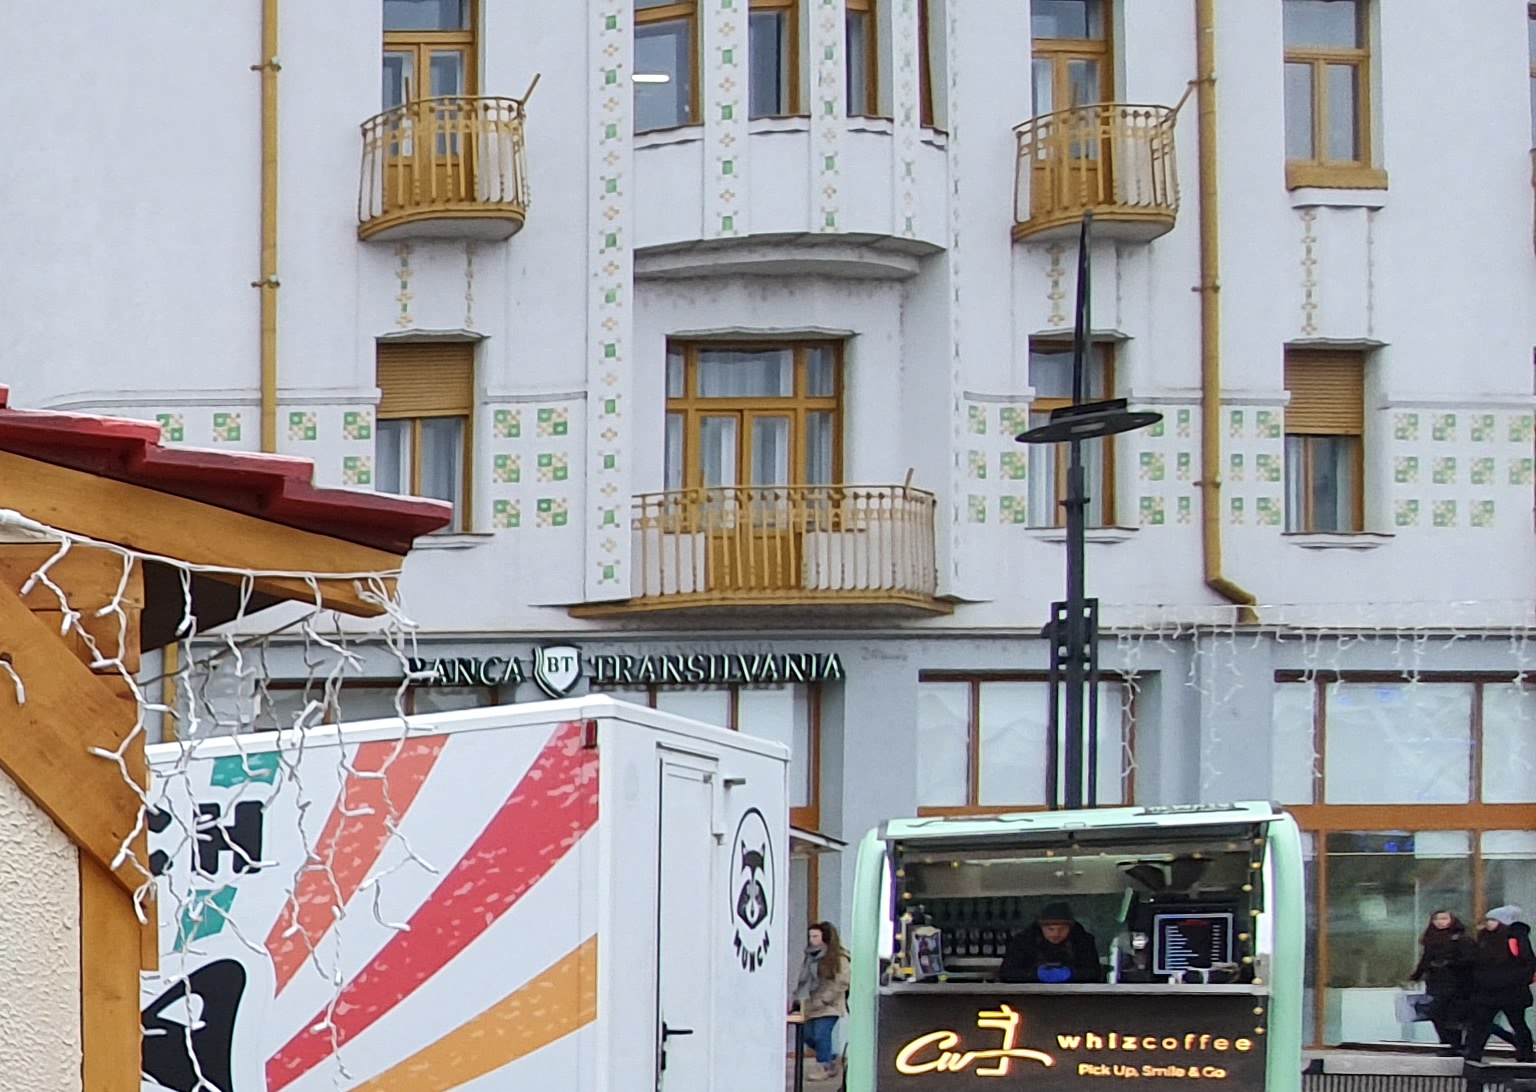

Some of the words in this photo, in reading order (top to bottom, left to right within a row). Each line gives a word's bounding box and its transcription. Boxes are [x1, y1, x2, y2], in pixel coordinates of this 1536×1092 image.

[546, 656, 576, 674] BT
[589, 653, 845, 684] TRANSILVANIA
[1078, 1063, 1112, 1077] Pick
[1141, 1064, 1186, 1078] Smile
[1187, 1066, 1200, 1078] &
[1201, 1066, 1227, 1078] Go
